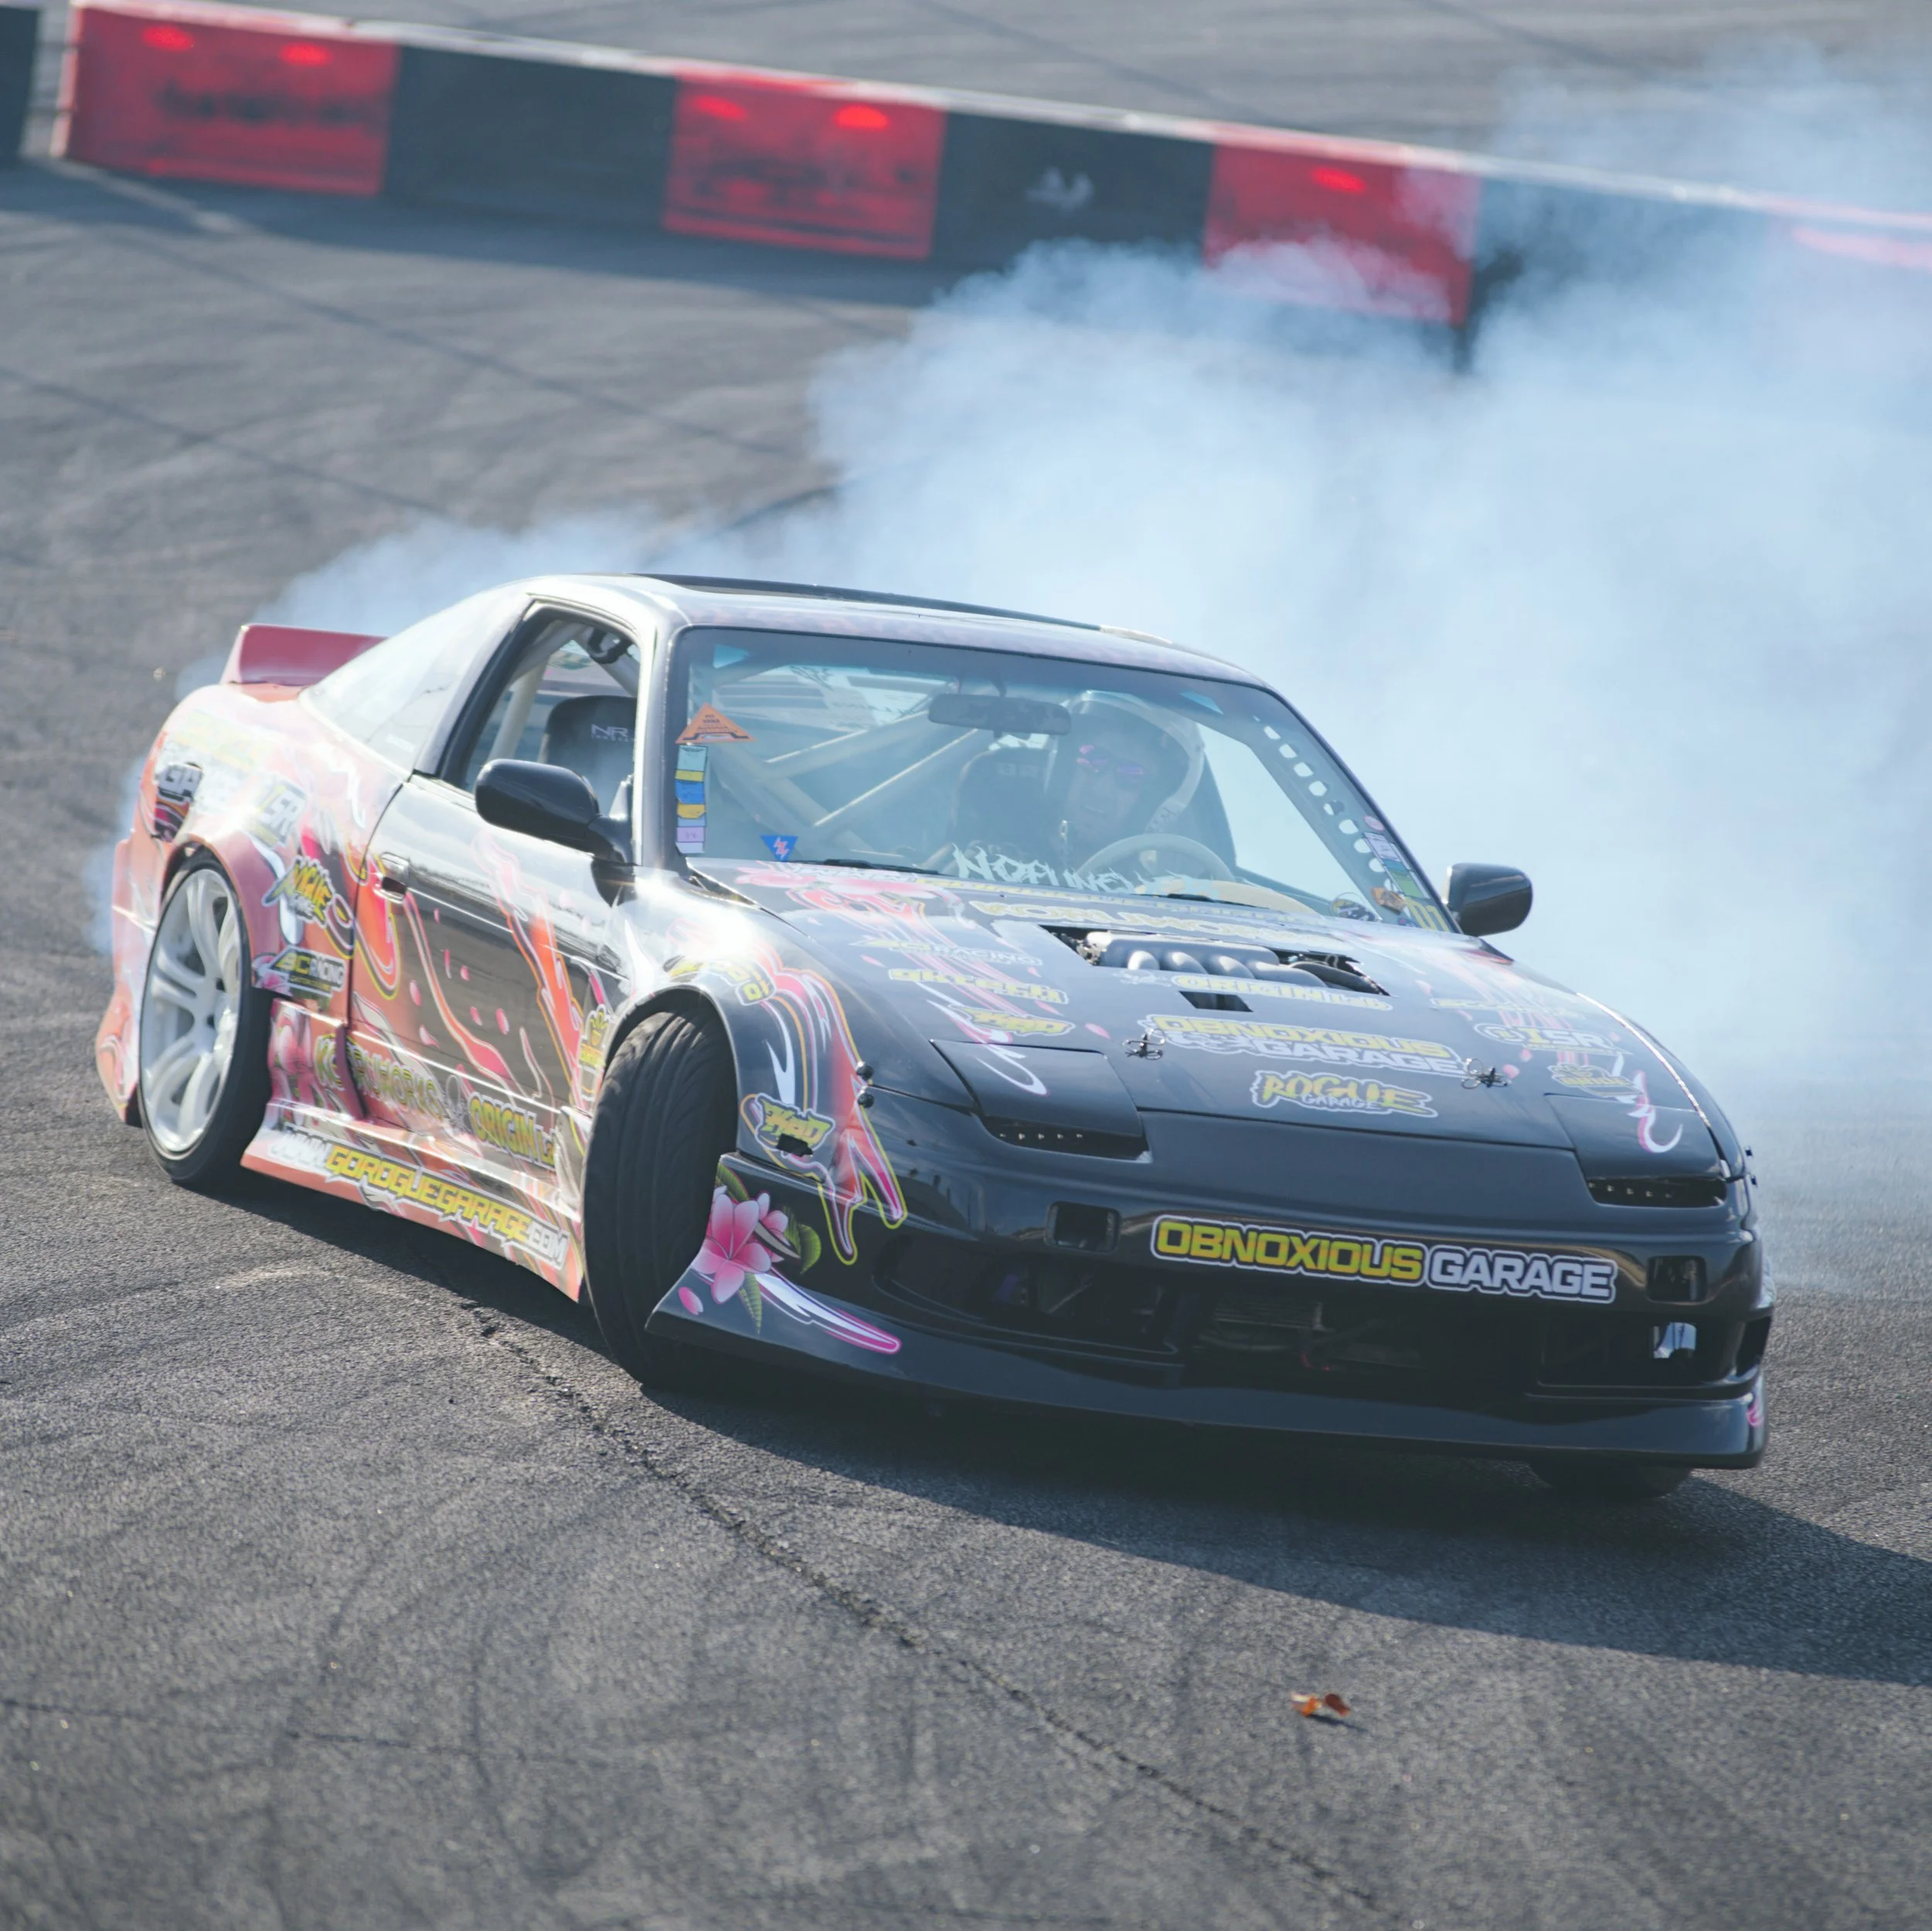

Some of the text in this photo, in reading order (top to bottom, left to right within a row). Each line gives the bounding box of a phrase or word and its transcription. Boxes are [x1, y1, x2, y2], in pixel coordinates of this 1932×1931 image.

[1177, 976, 1322, 1001] ORIGIN
[1155, 1016, 1452, 1059] OBNOXIOUS
[1250, 1039, 1467, 1073] GARAGE
[1263, 1073, 1429, 1114] ROGUE
[1301, 1093, 1383, 1110] GARAGE
[469, 1094, 539, 1161] ORIGIN
[1156, 1221, 1613, 1298] OBNOXIOUS GARAGE
